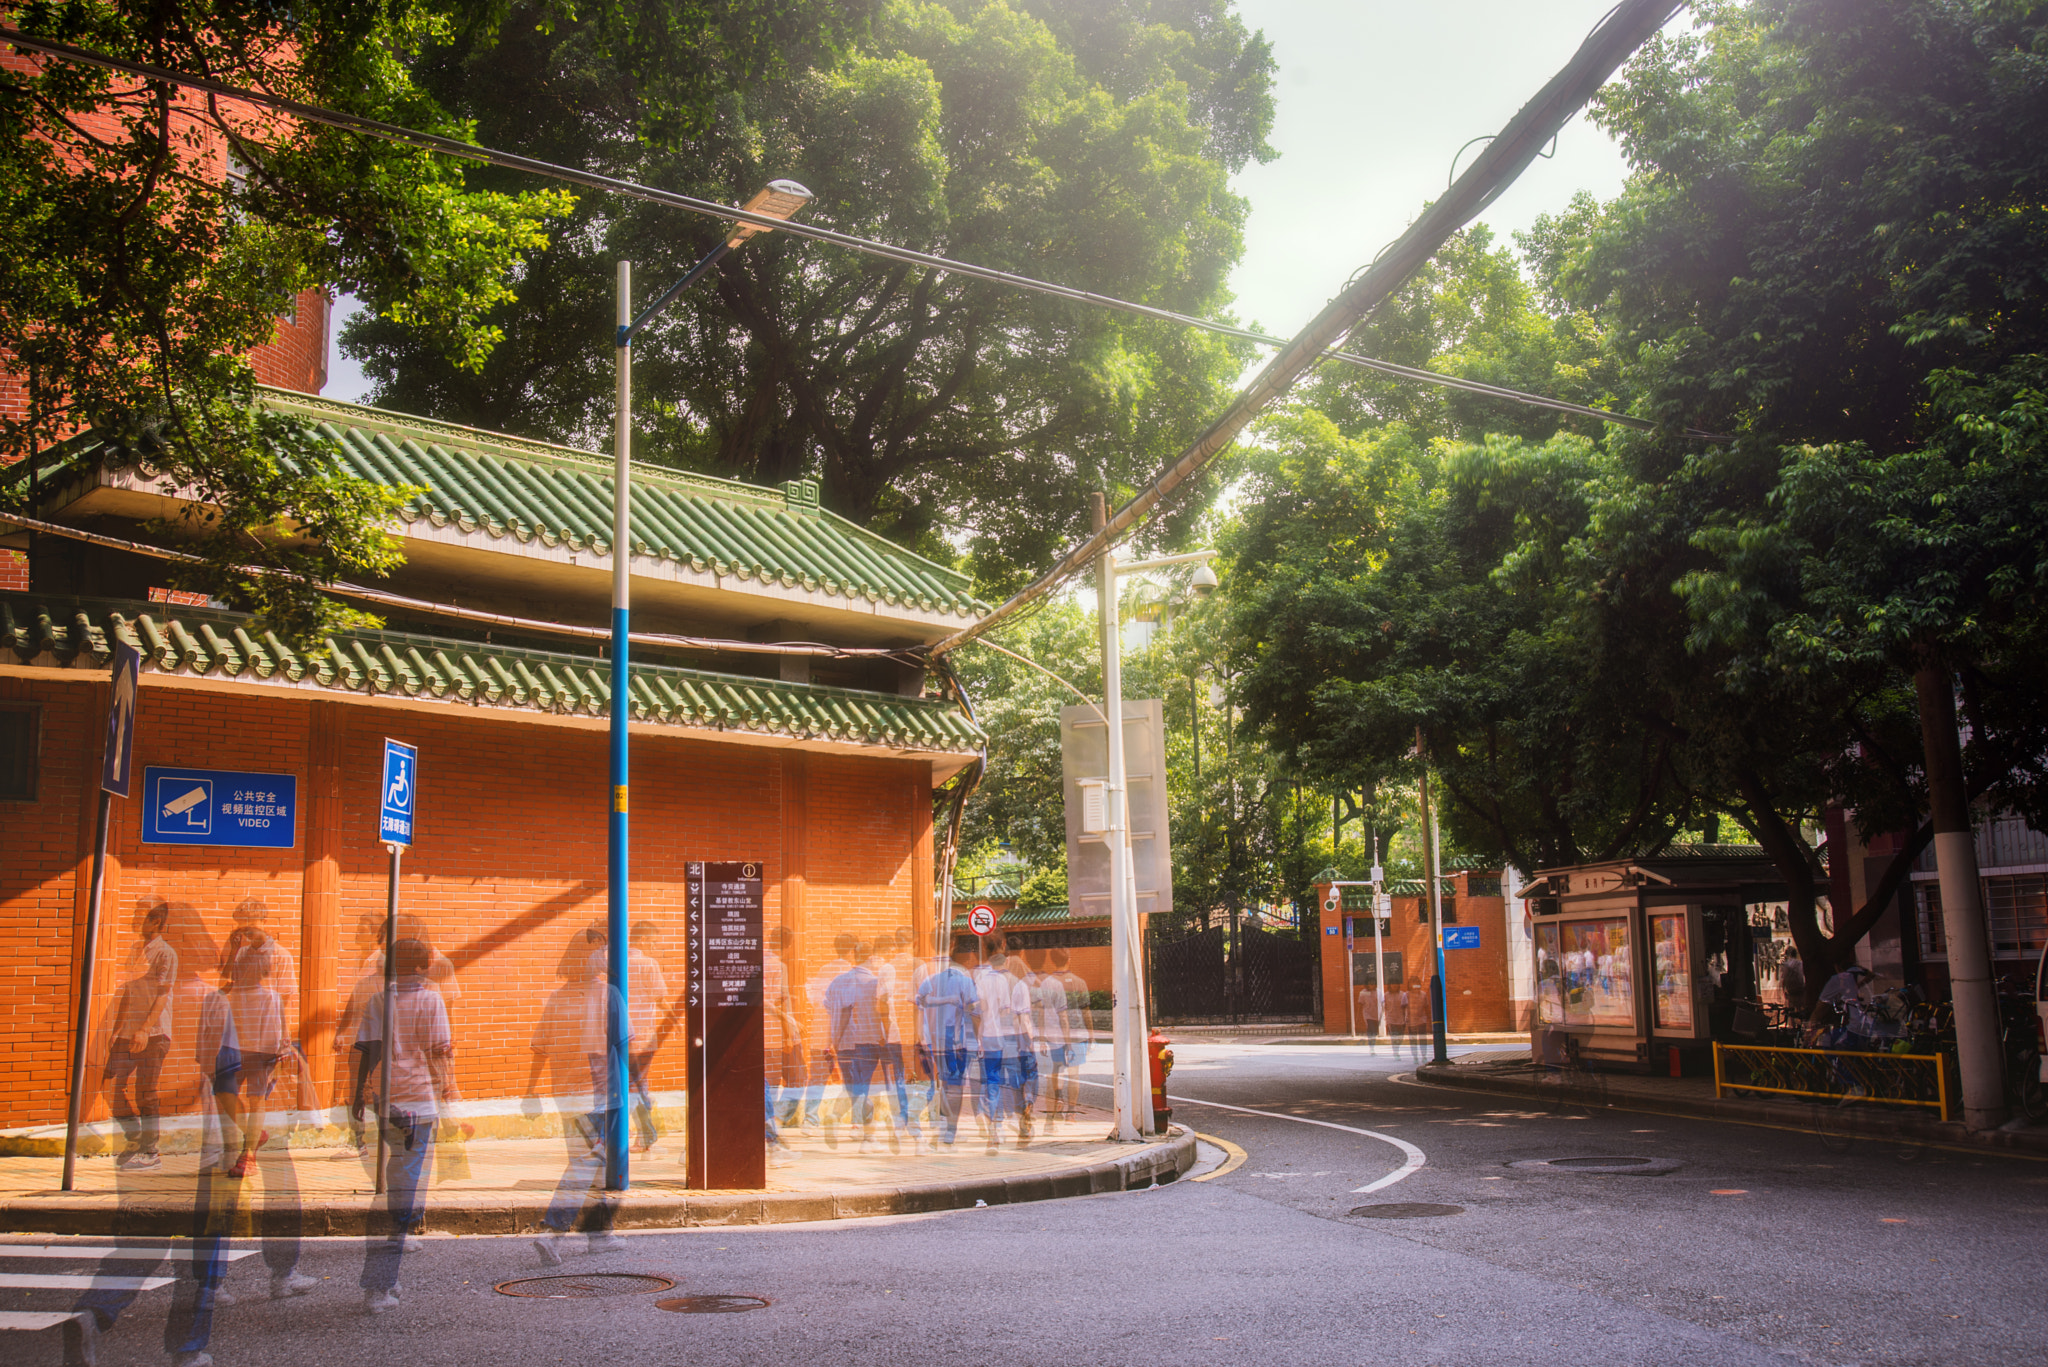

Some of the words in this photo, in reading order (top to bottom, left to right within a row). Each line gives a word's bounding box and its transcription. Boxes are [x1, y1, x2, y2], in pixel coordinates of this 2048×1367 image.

[234, 790, 276, 803] 公共安全
[222, 803, 287, 817] 视频监控区域
[238, 818, 270, 828] VIDEO
[382, 816, 410, 836] 无障碍通道
[690, 864, 700, 875] 北
[708, 938, 758, 946] 越秀区东山少年宫
